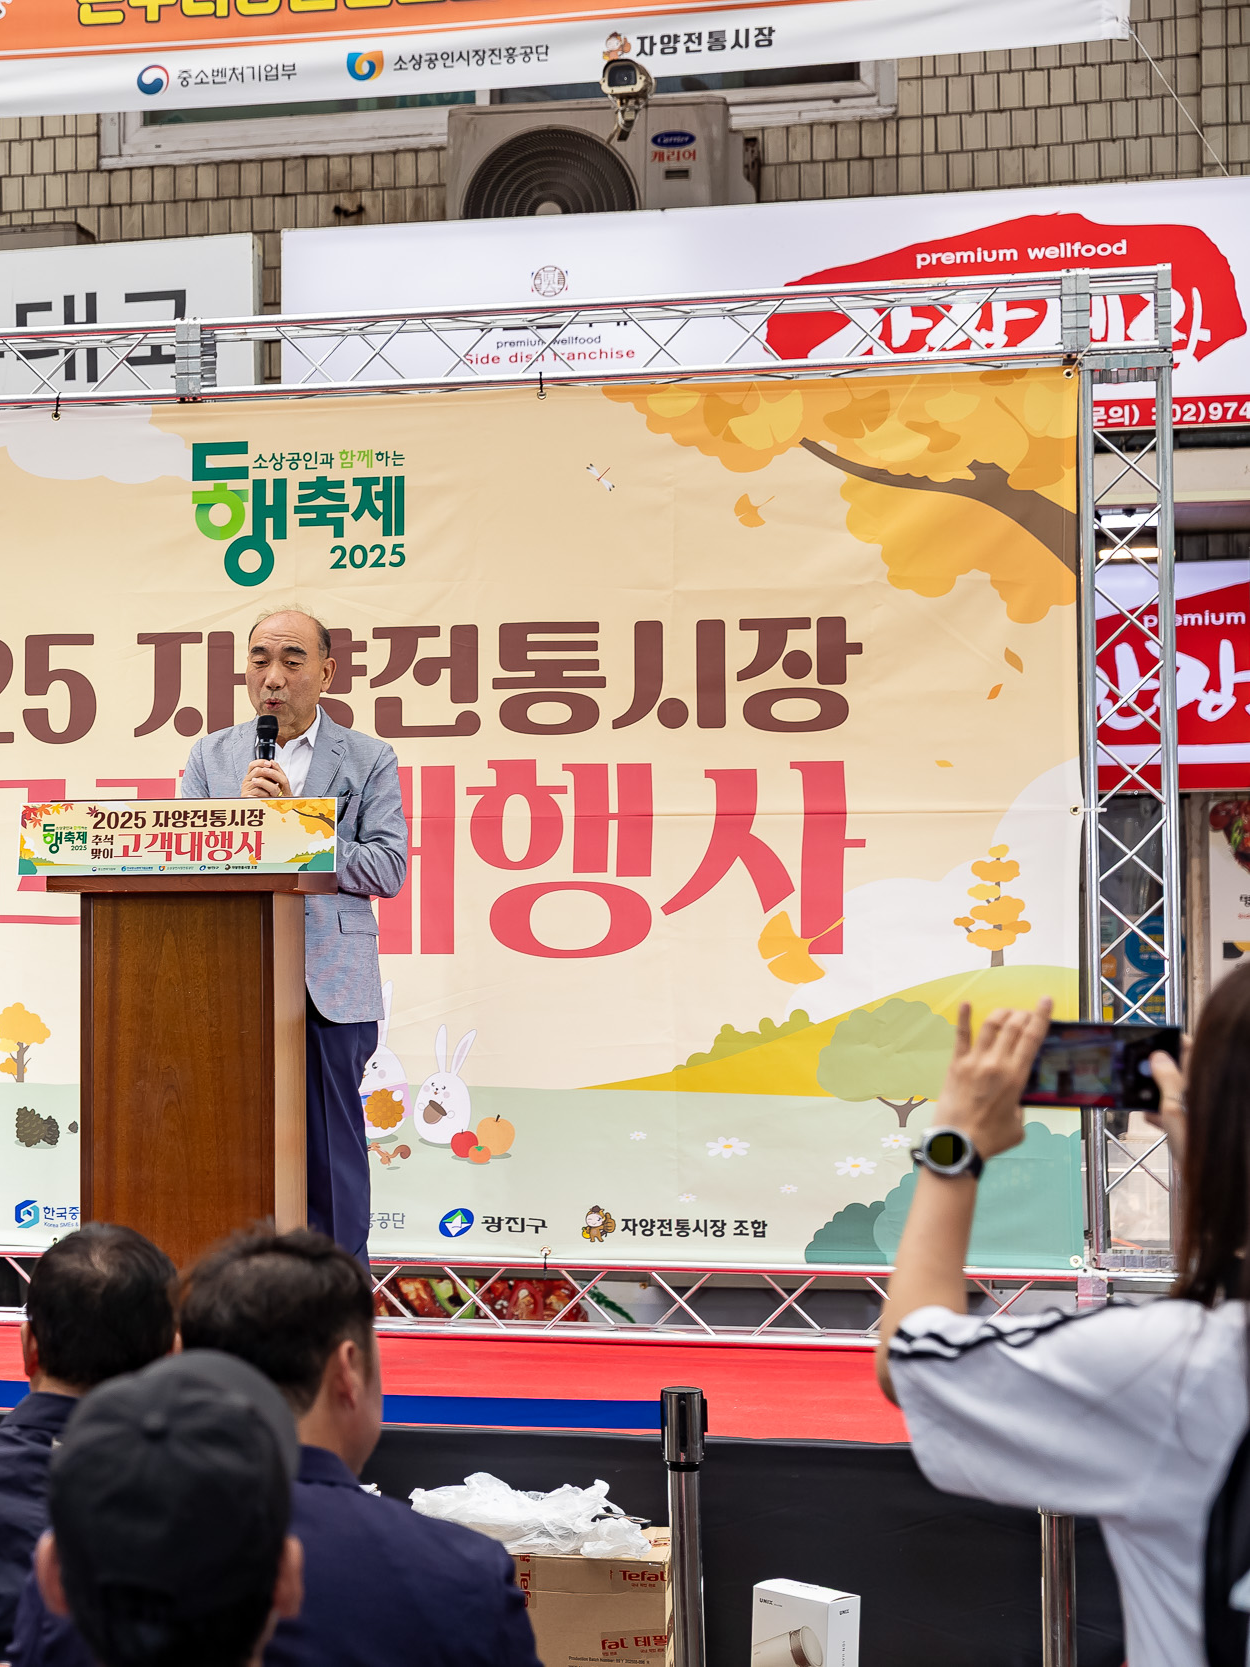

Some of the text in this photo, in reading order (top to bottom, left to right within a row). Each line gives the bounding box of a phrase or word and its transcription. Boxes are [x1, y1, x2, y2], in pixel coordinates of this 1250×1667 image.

[636, 26, 776, 57] 자양전통시장
[393, 44, 549, 73] 소상공인시장진흥공단
[177, 62, 298, 87] 중소벤처기업부
[657, 134, 690, 144] Carrier
[651, 149, 697, 162] 캐리어
[916, 239, 1127, 269] premium wellfood
[252, 451, 334, 471] 소상공인과
[330, 543, 406, 570] 2025
[92, 808, 266, 830] 2025 자양전통시장
[91, 834, 114, 847] 추석
[114, 831, 266, 862] 고객대행사
[91, 848, 114, 860] 맞이
[481, 1215, 548, 1235] 광진구
[620, 1217, 768, 1239] 자양전통시장 조합
[619, 1570, 667, 1582] Tefal
